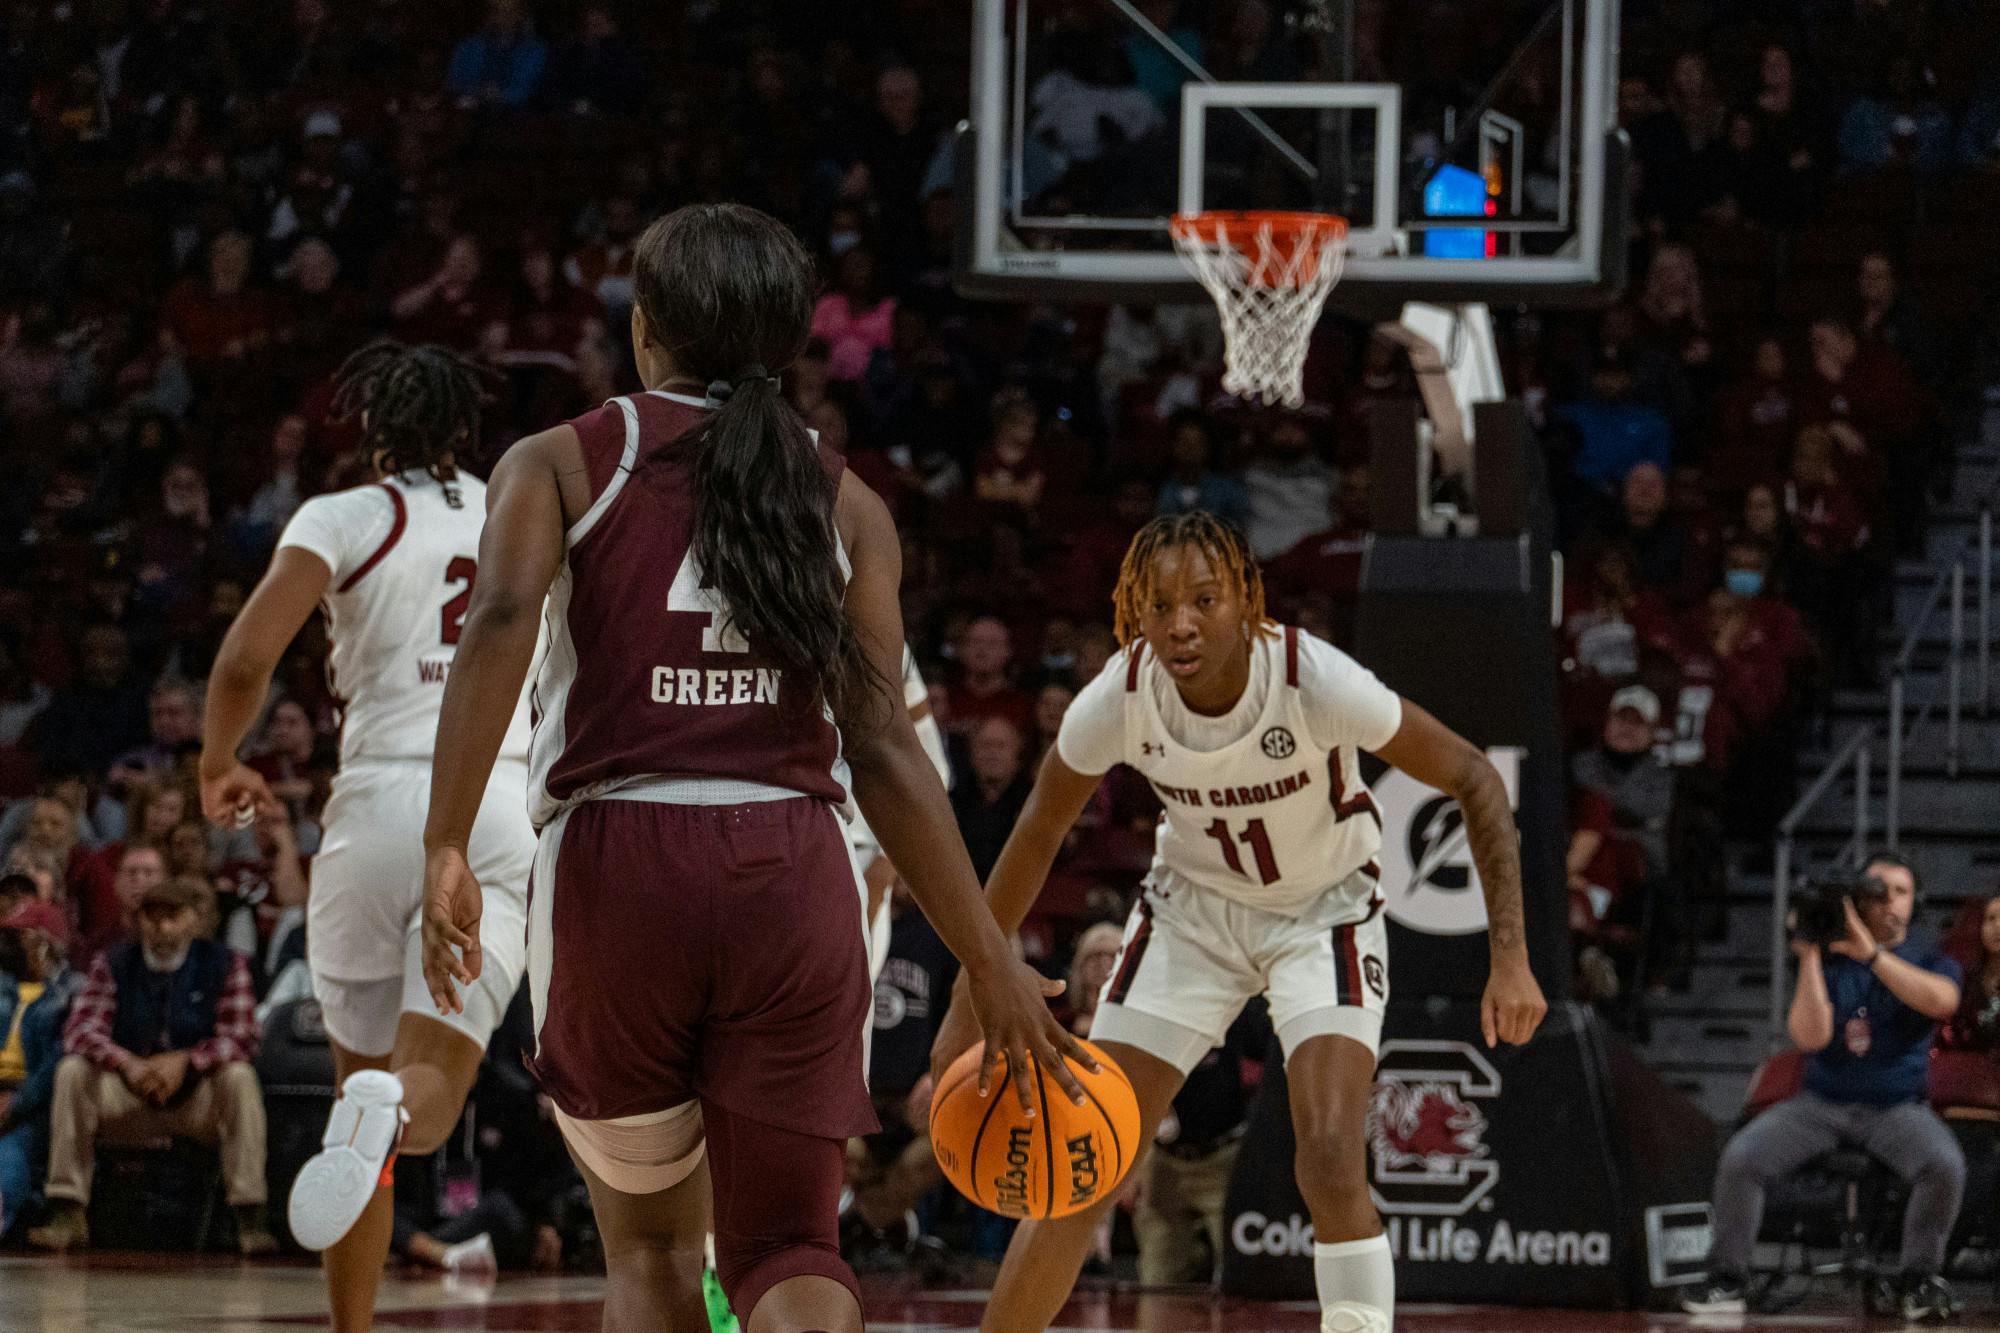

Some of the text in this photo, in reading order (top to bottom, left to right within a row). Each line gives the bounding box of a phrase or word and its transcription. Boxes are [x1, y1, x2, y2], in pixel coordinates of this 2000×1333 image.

[441, 555, 477, 645] 2
[651, 665, 782, 706] GREEN
[1208, 769, 1312, 808] CAROLINA
[1203, 817, 1282, 887] 11
[1067, 1131, 1098, 1207] NCAA
[1408, 1217, 1481, 1263] Life
[1485, 1218, 1611, 1266] Arena
